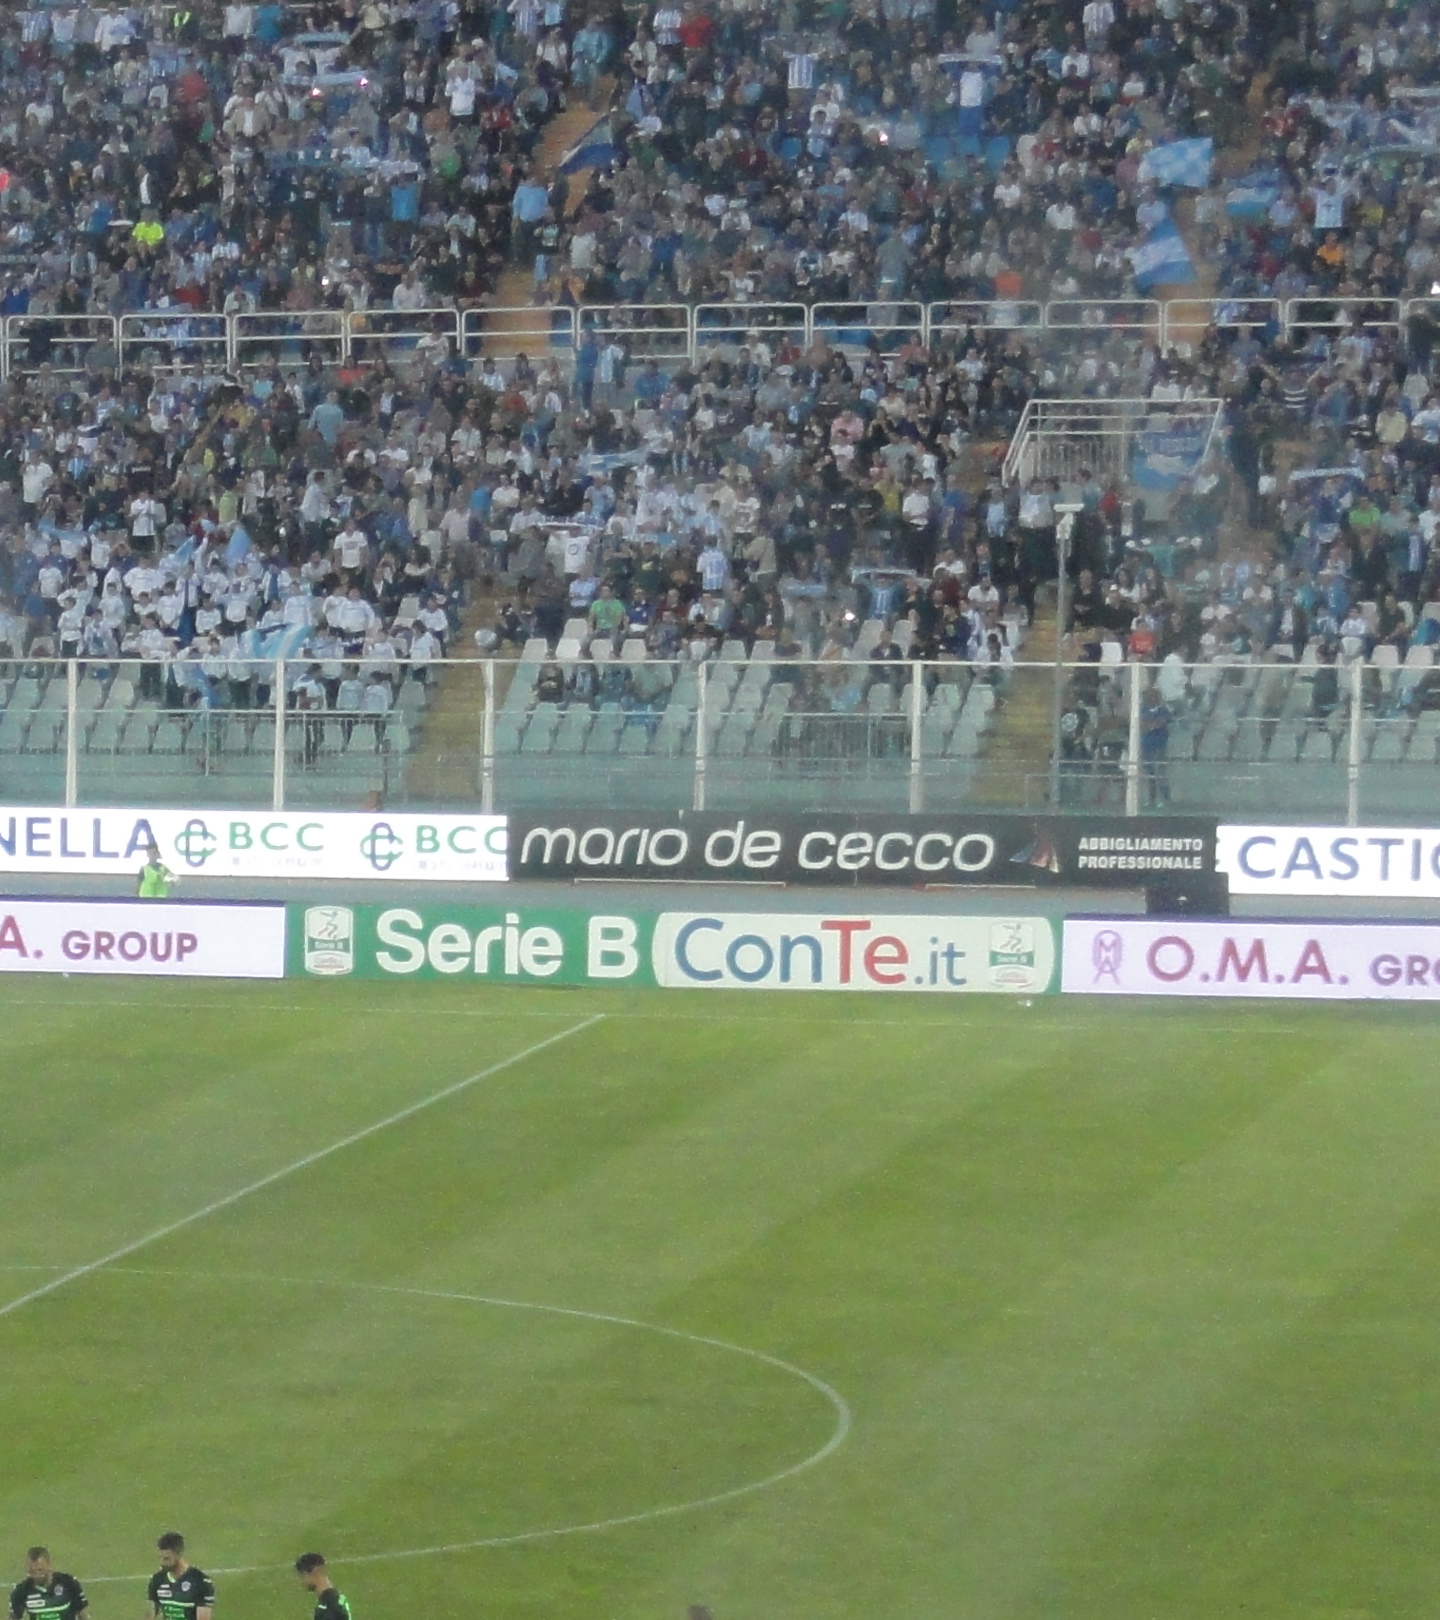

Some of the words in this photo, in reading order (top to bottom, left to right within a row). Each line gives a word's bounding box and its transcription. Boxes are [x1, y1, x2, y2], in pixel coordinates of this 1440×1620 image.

[229, 822, 324, 851] BCC
[521, 826, 688, 868] mario
[704, 820, 780, 870] de
[798, 831, 995, 872] cecco
[1078, 836, 1204, 852] ABBIGLIAMENTO
[1078, 854, 1203, 870] PROFESSIONALE
[60, 928, 199, 964] GROUP
[376, 908, 564, 977] Serie
[587, 916, 639, 979] B
[674, 916, 967, 987] ConTe.it
[1145, 935, 1350, 985] O.M.A.
[1370, 953, 1440, 987] GR
